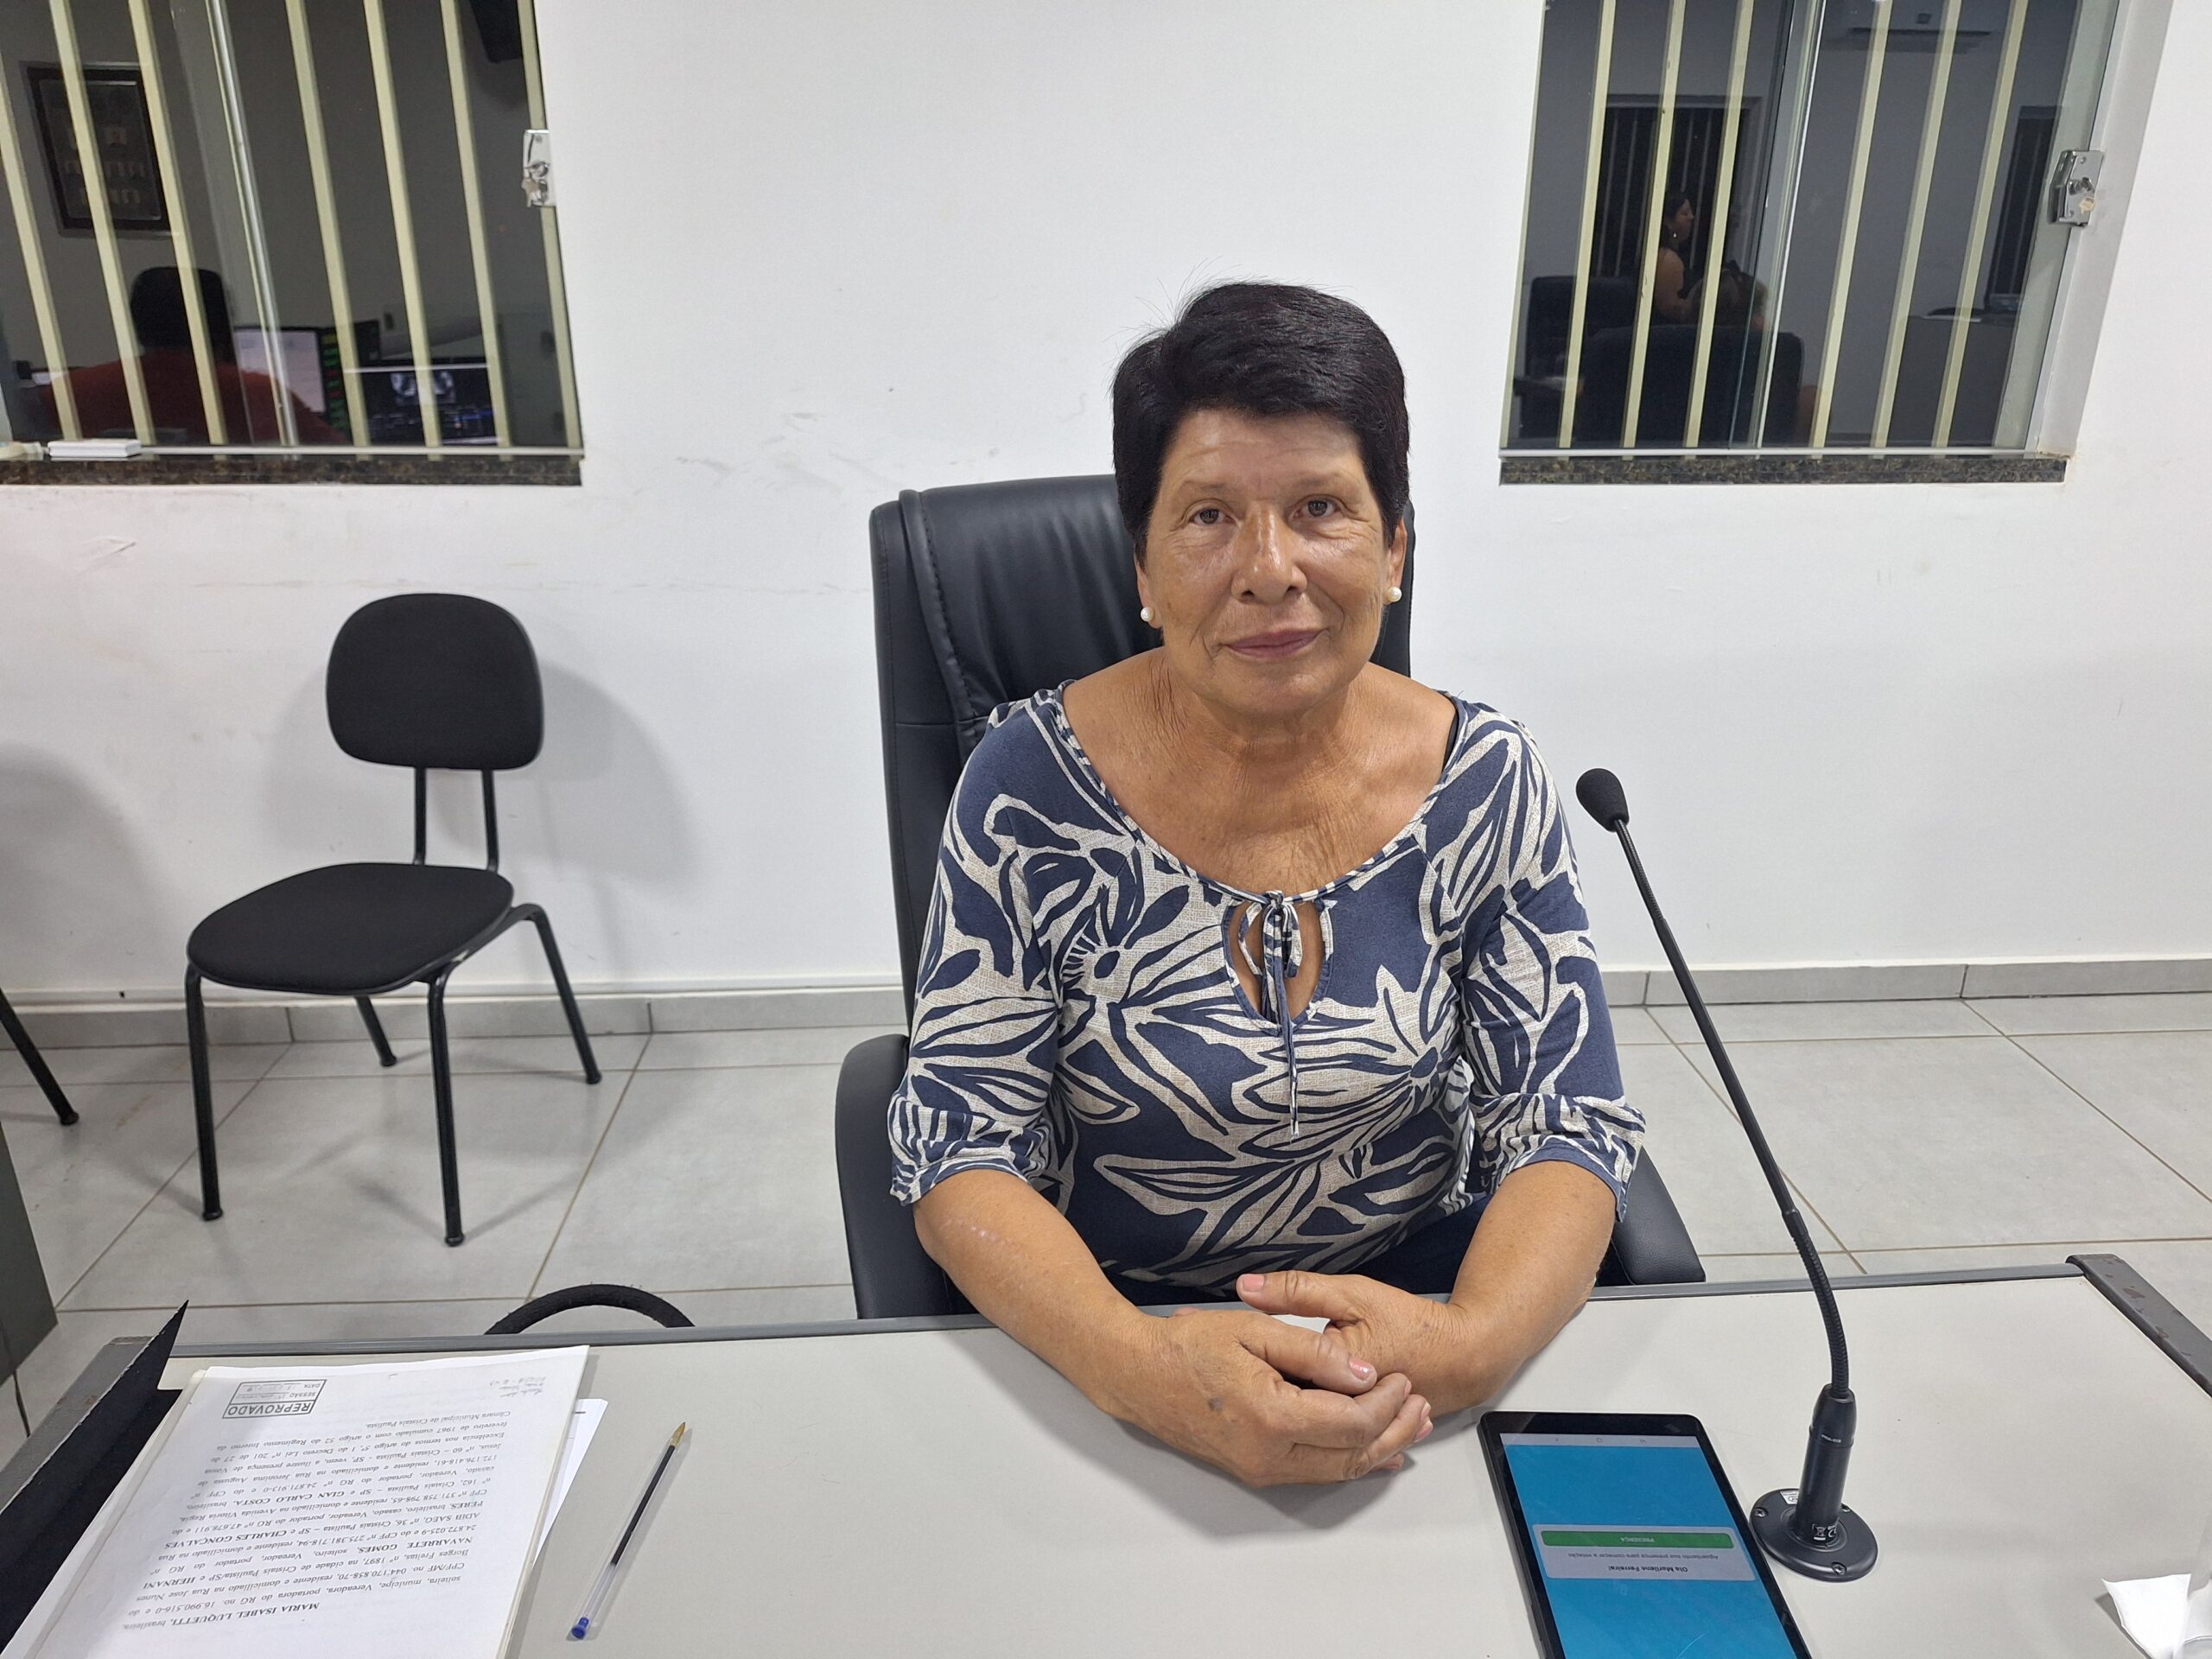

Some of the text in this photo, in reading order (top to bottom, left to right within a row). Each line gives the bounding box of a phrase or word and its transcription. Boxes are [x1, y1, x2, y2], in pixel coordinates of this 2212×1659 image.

[227, 1402, 312, 1416] REPROVADO
[398, 1418, 428, 1427] Cristais
[440, 1414, 480, 1422] Municipal
[473, 1421, 507, 1429] fevereiro
[394, 1427, 433, 1437] cumulado
[262, 1438, 307, 1446] Regimento
[375, 1452, 407, 1460] Paulista
[410, 1448, 441, 1457] Cristais
[246, 1461, 283, 1470] presença
[392, 1460, 429, 1469] residente
[330, 1465, 379, 1475] domiciliado
[378, 1471, 413, 1482] portador
[386, 1484, 419, 1492] Paulista
[423, 1480, 454, 1489] Cristais
[468, 1488, 487, 1497] CPF
[275, 1493, 313, 1503] CARLO
[350, 1497, 388, 1506] residente
[290, 1502, 341, 1512] domiciliado
[240, 1508, 276, 1516] Avenida
[288, 1513, 326, 1523] portador
[322, 1523, 356, 1532] Paulista
[359, 1520, 391, 1529] Cristais
[235, 1529, 287, 1541] CHARLES
[378, 1531, 397, 1540] CPF
[164, 1535, 232, 1548] GONÇALVES
[253, 1541, 293, 1549] residente
[406, 1537, 472, 1548] NAVARRETE
[191, 1546, 244, 1557] domiciliado
[213, 1555, 252, 1567] portador
[315, 1560, 344, 1570] cidade
[168, 1565, 185, 1573] RG
[263, 1565, 296, 1575] Cristais
[426, 1562, 465, 1572] CPF/MF
[207, 1569, 259, 1581] Paulista/SP
[292, 1574, 333, 1584] residente
[143, 1576, 195, 1589] HERNANI
[227, 1580, 281, 1592] domiciliado
[260, 1593, 273, 1602] do
[277, 1587, 321, 1599] portadora
[239, 1596, 257, 1605] RG
[280, 1602, 319, 1611] MARIA
[235, 1606, 276, 1618] ISABEL
